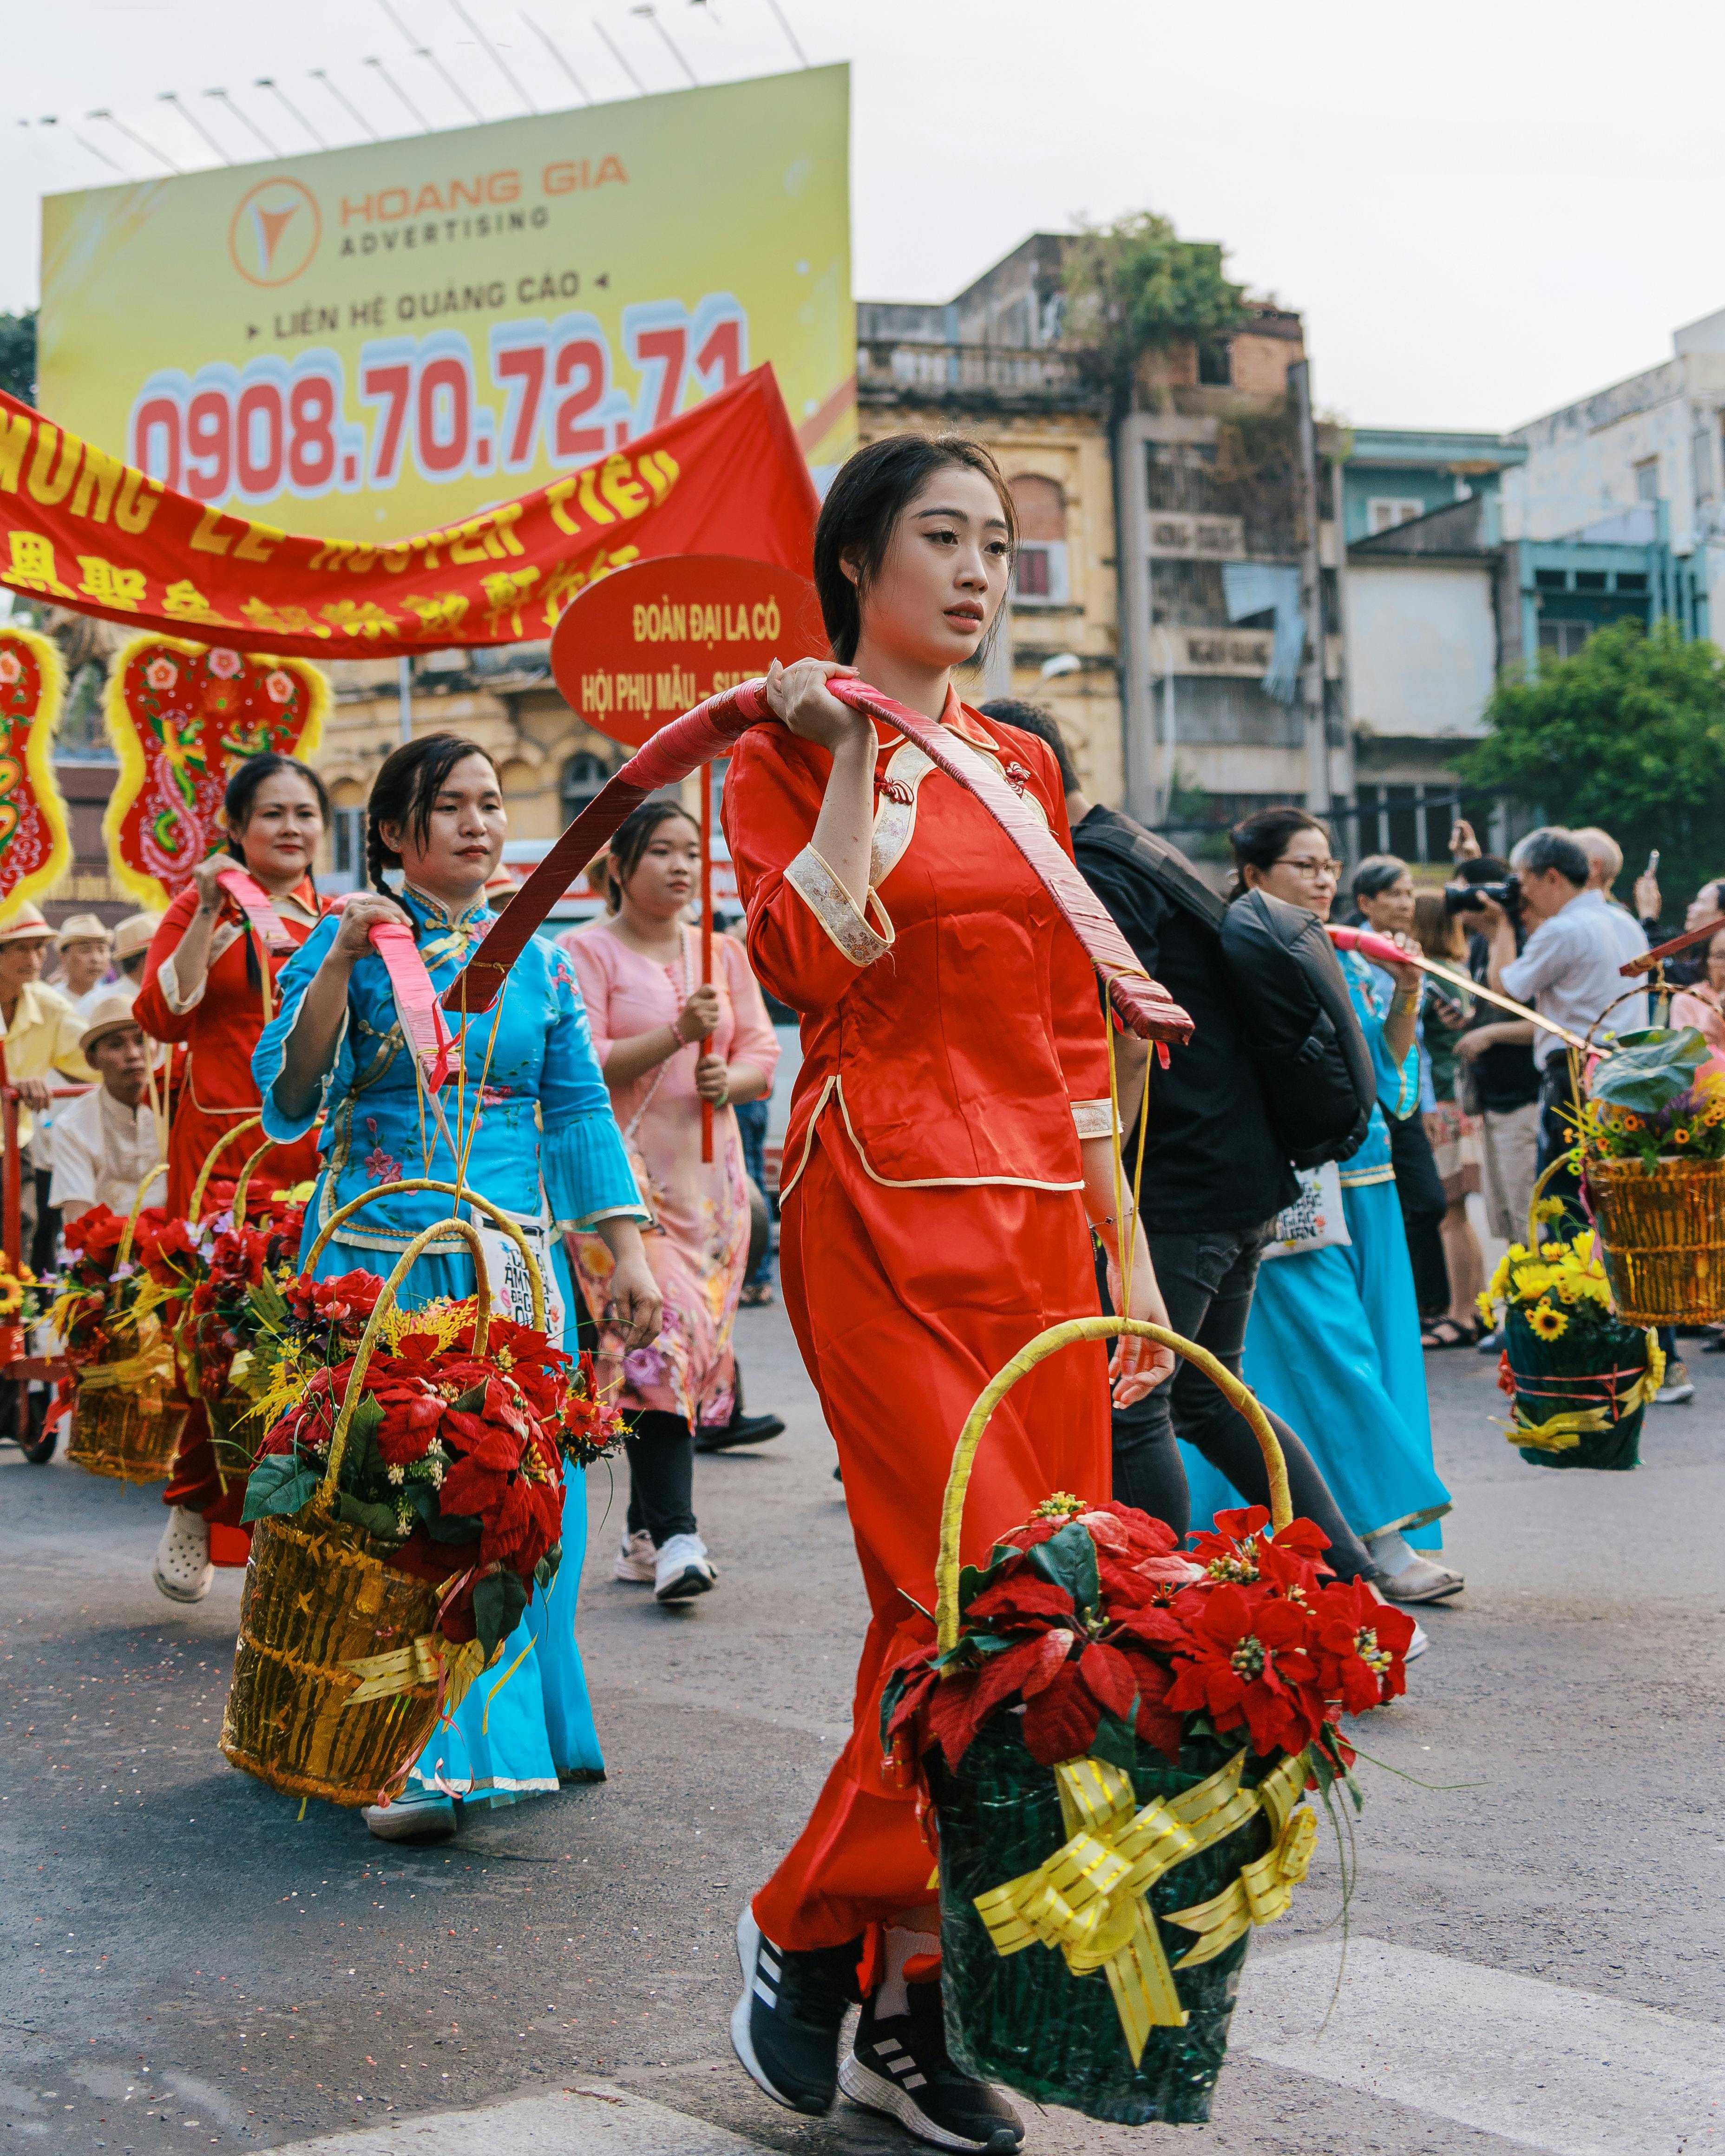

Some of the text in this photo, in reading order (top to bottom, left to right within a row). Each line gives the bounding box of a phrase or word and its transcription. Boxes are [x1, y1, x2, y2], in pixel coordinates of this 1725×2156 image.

[339, 153, 628, 227] HOANG GIA
[340, 205, 548, 257] ADVERTISING
[273, 269, 580, 340] LIÊN HỆ QUẢNG CÁO
[135, 320, 740, 501] 0908.70.72.71
[632, 594, 686, 642] ĐOÀN
[690, 603, 721, 650] ĐẠI
[724, 603, 750, 641] LA
[581, 667, 613, 721] HỘI
[616, 673, 652, 720] PHỤ
